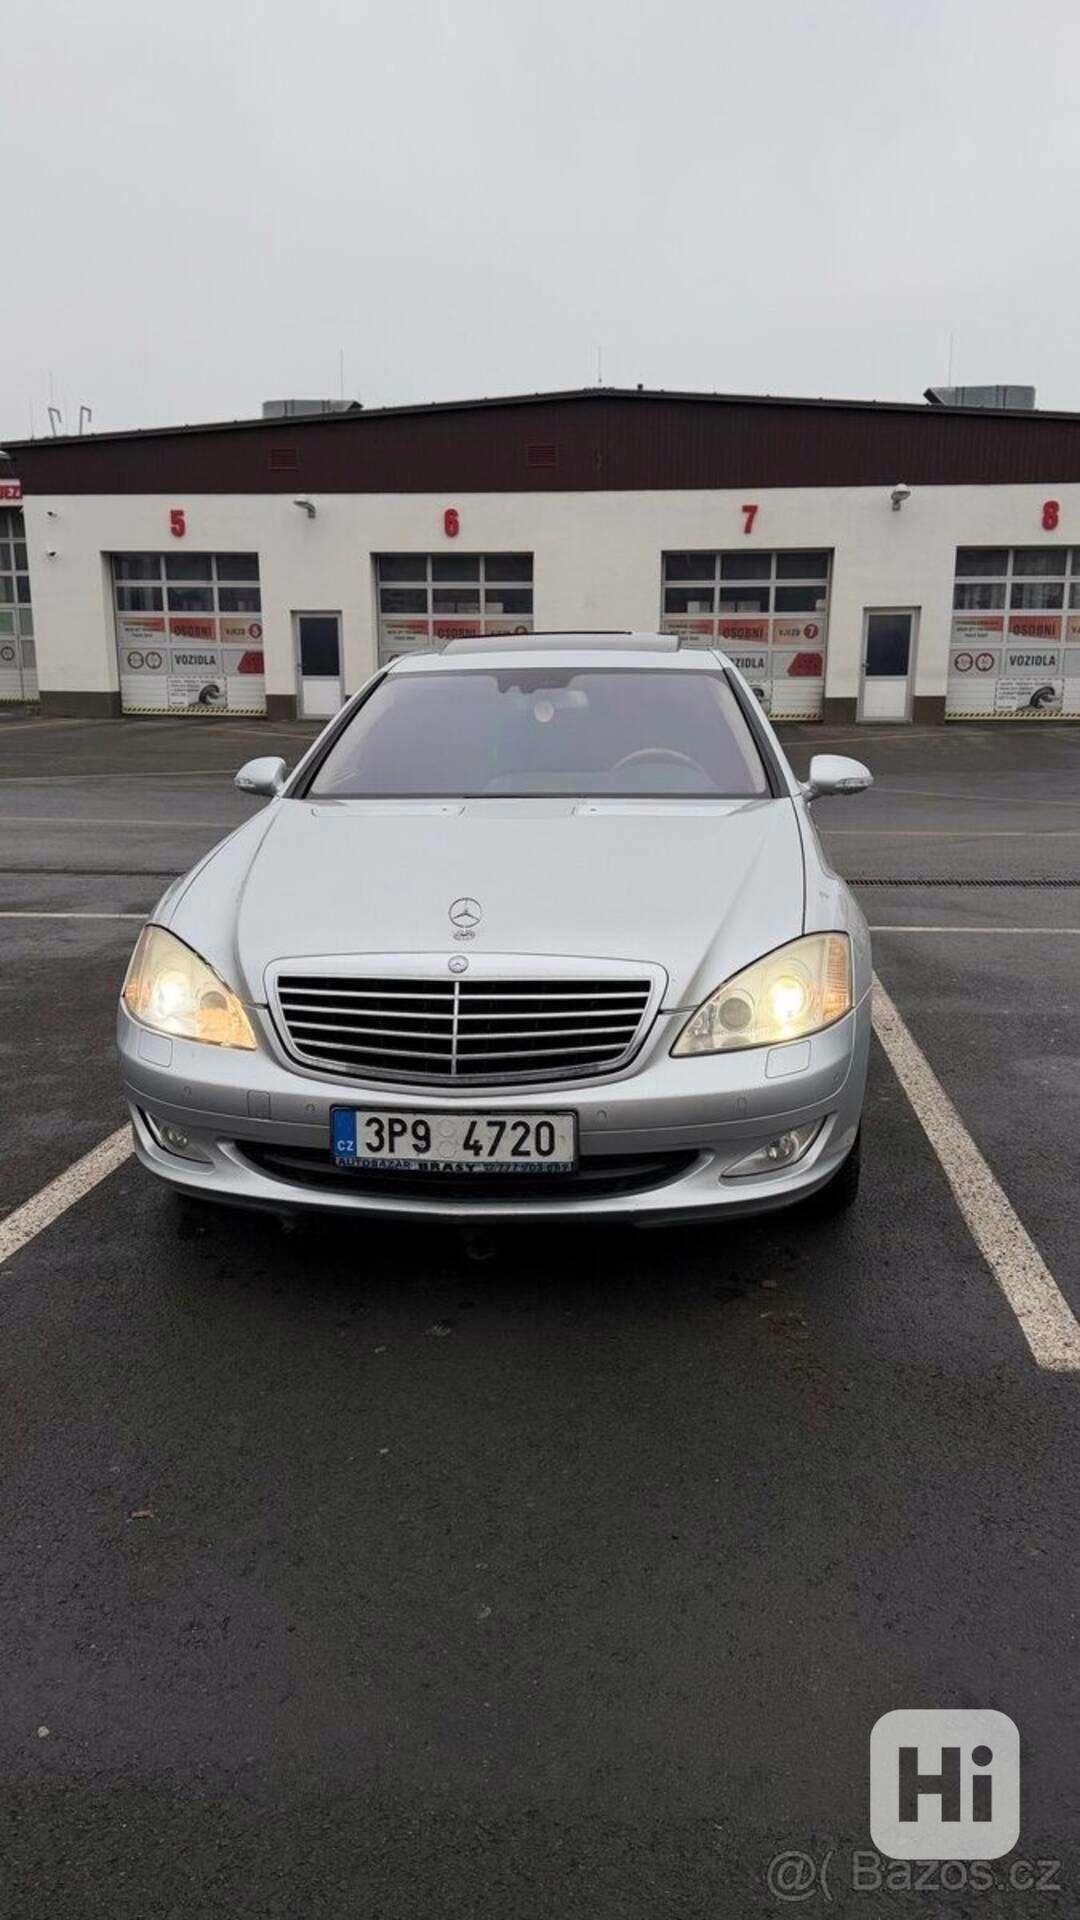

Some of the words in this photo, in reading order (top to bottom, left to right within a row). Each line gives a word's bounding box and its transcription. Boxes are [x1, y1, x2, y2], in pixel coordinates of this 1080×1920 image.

[170, 509, 186, 538] 5
[444, 508, 459, 538] 6
[741, 505, 758, 534] 7
[1042, 500, 1060, 530] 8
[175, 654, 216, 666] VOZIDLA
[731, 657, 765, 669] ZIDLA
[1010, 655, 1056, 667] VOZIDLA
[336, 1140, 354, 1152] CZ
[364, 1117, 431, 1154] 3P9
[463, 1120, 555, 1157] 4720
[337, 1157, 411, 1170] AUTOBAZAR
